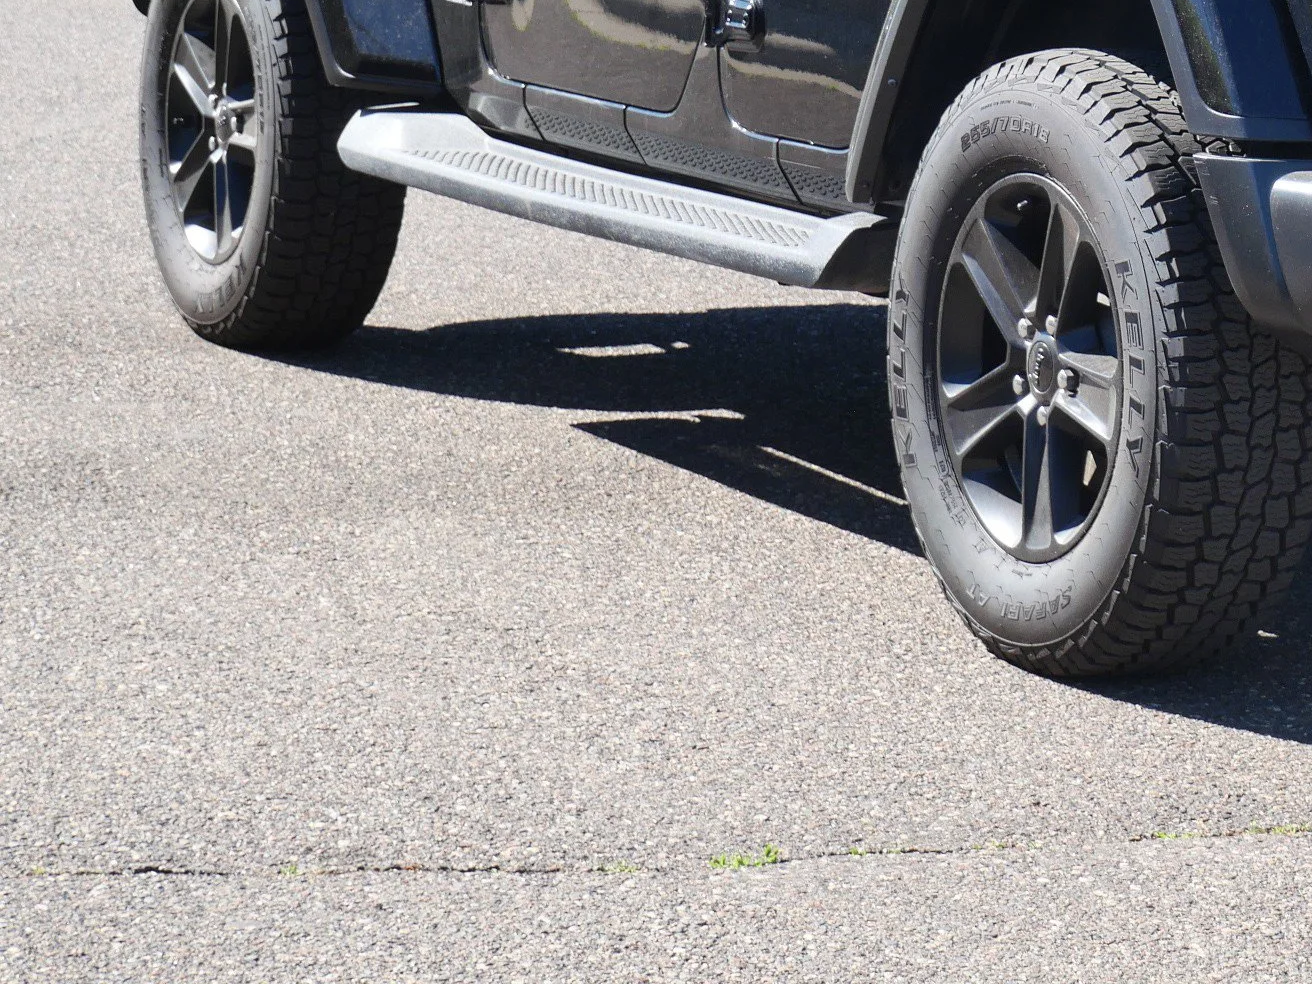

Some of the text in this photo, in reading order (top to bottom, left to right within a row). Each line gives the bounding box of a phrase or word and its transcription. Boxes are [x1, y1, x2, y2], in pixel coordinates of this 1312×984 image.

[892, 289, 918, 467] KELLY
[1114, 259, 1146, 480] KELLY
[1000, 585, 1073, 622] SAFARI
